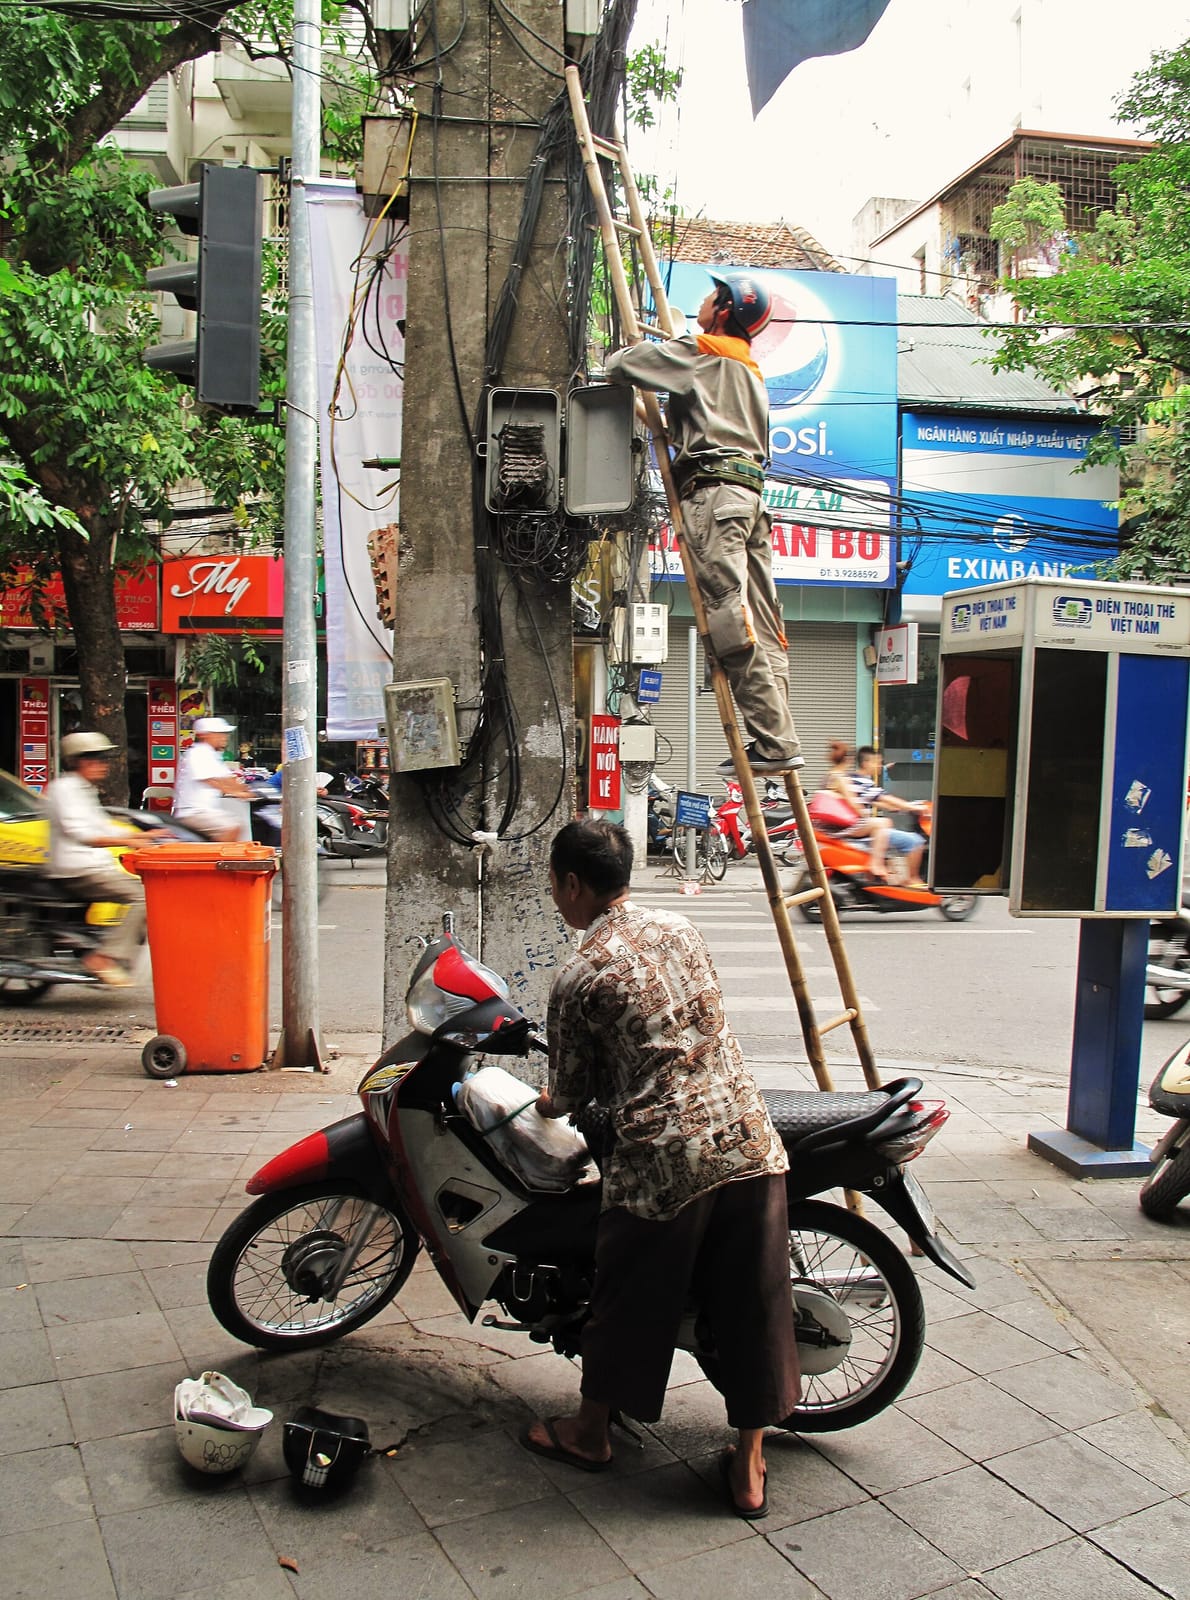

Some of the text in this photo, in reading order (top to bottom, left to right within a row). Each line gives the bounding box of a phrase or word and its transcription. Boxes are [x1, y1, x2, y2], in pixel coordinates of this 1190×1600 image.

[917, 426, 947, 442] NGÂN
[948, 427, 976, 444] HÀNG
[979, 427, 1004, 445] XUẤT
[1007, 431, 1033, 448] NHẬP
[947, 557, 1073, 580] EXIMBANK
[170, 557, 251, 615] My
[972, 599, 985, 616] ĐIỆN
[1095, 597, 1175, 619] ĐIỆN THOẠI THẺ
[980, 615, 1007, 632] VIỆT NAM
[1111, 616, 1160, 635] VIỆT NAM
